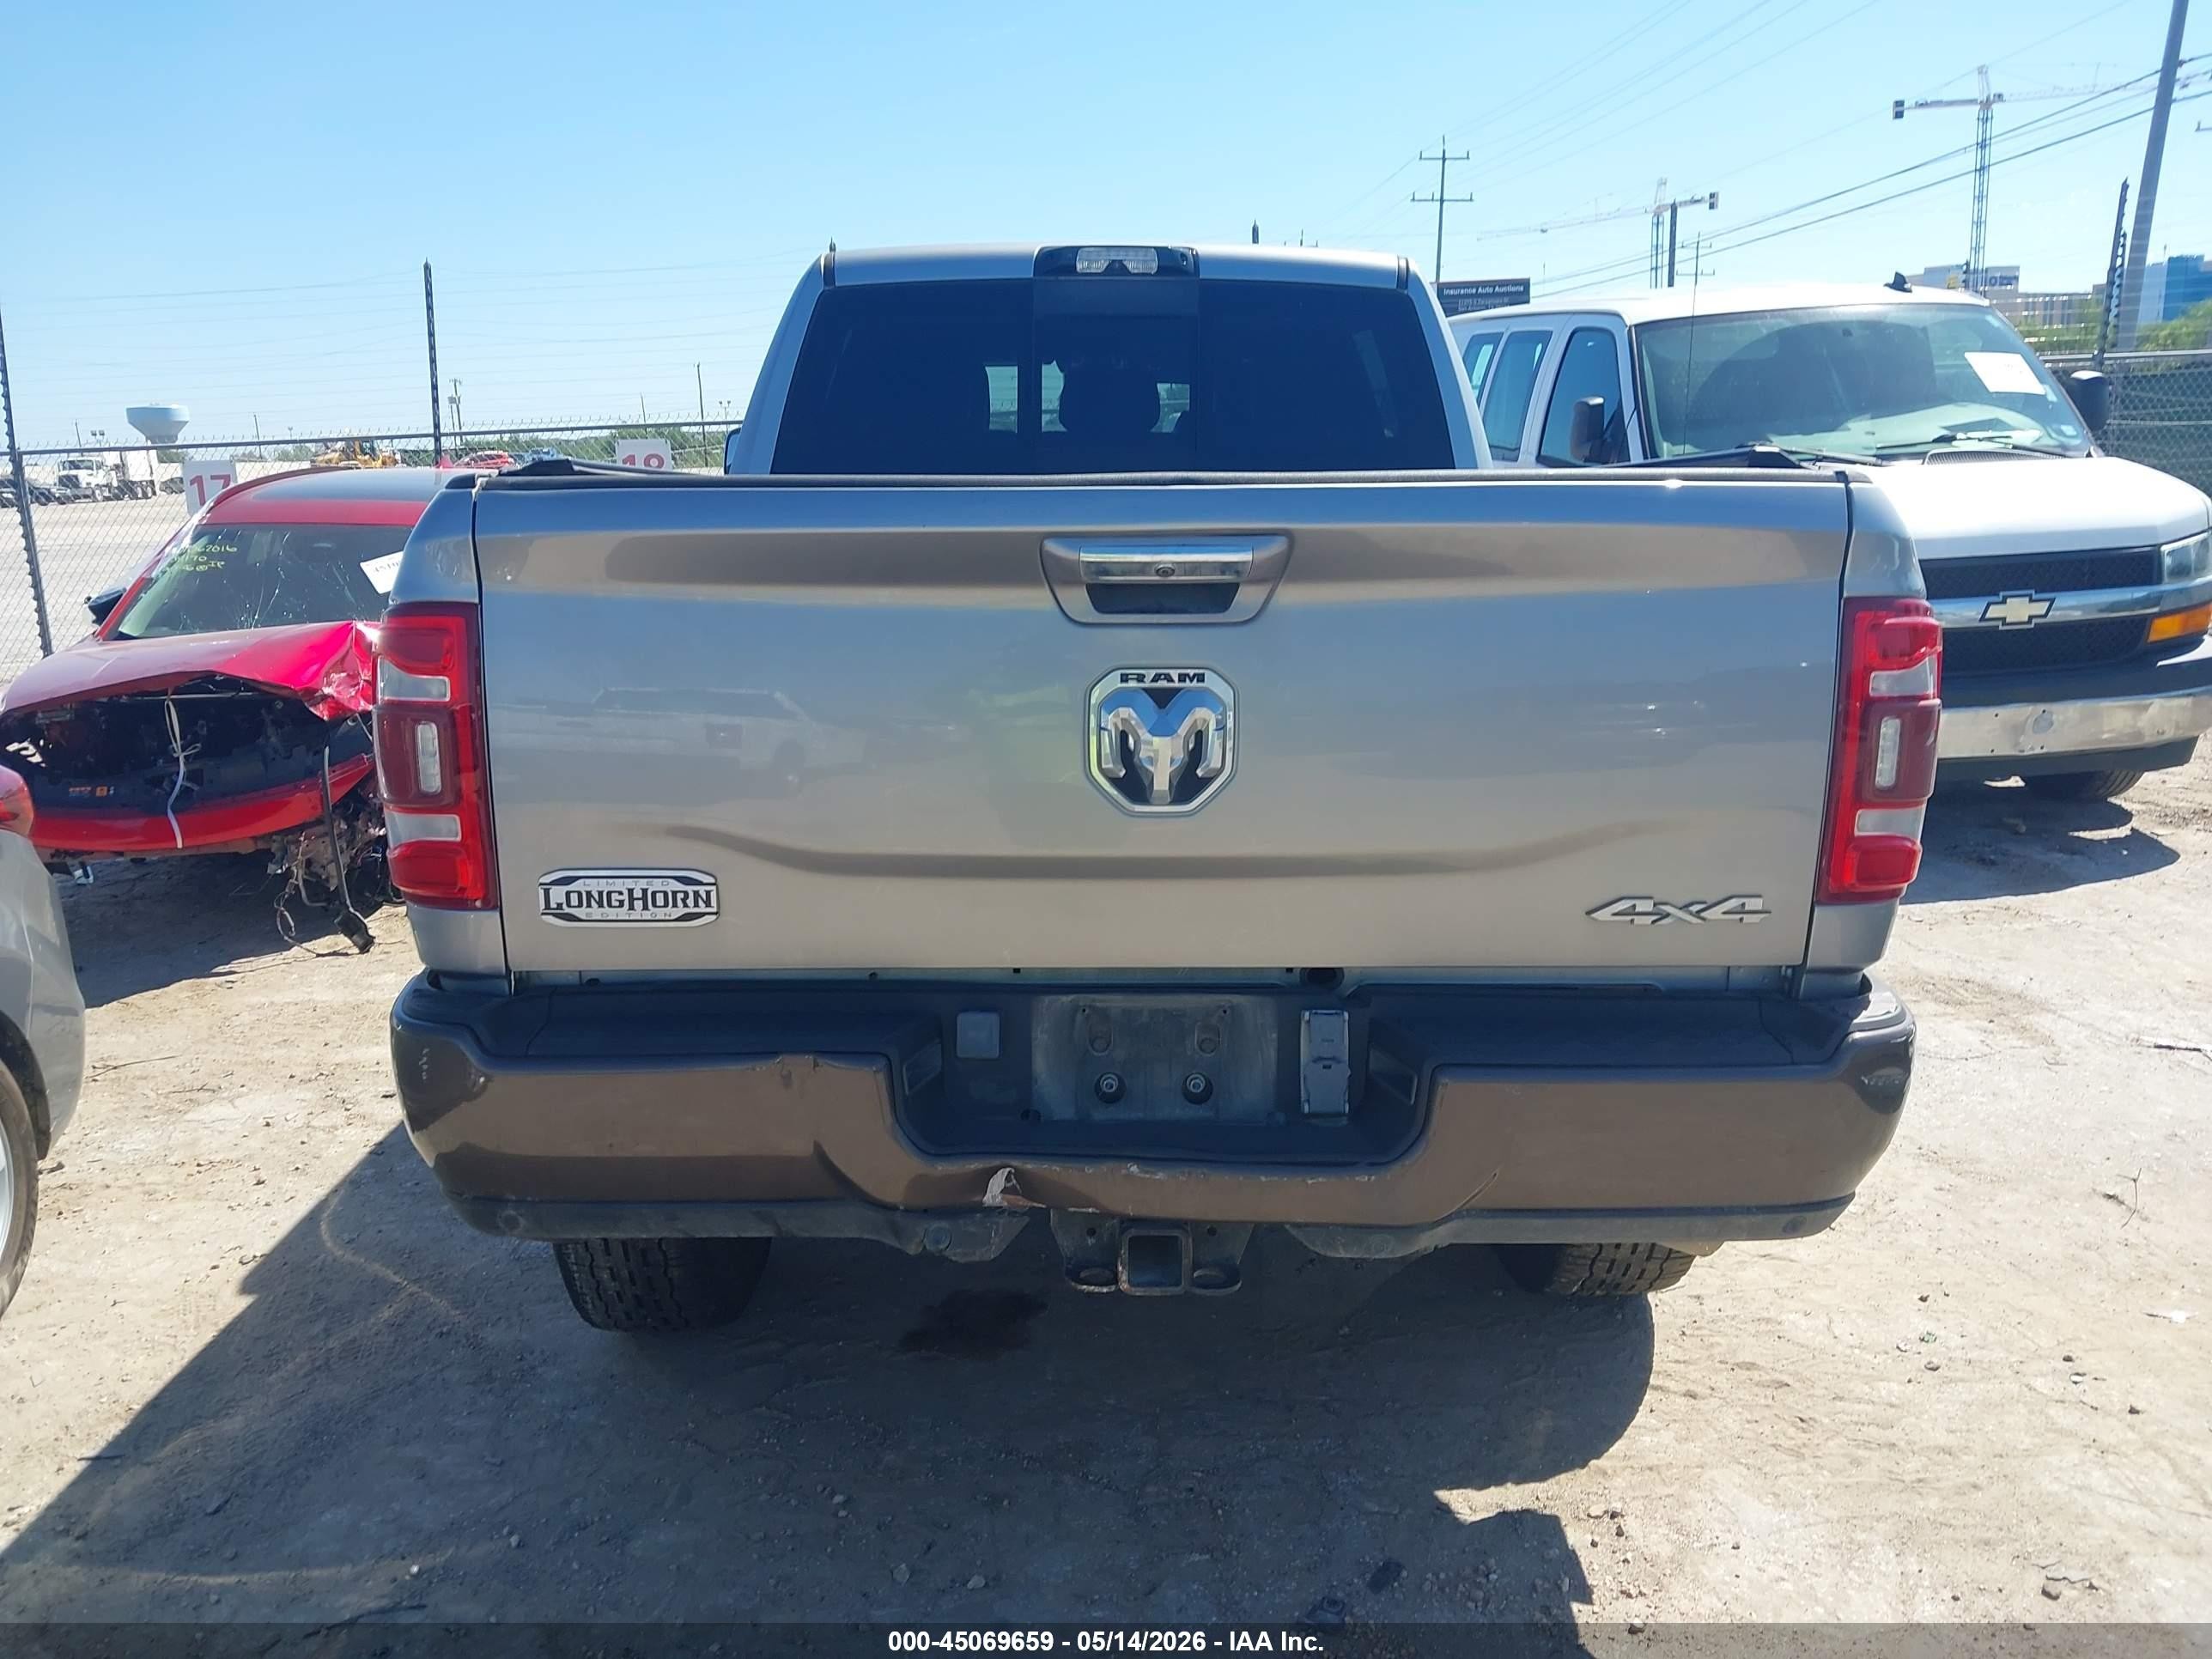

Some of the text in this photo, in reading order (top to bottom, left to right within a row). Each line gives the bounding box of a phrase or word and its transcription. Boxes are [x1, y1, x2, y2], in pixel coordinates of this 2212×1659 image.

[1443, 283, 1524, 296] Insurance Auto Auctions
[189, 473, 231, 507] 17
[1120, 672, 1206, 684] RAM
